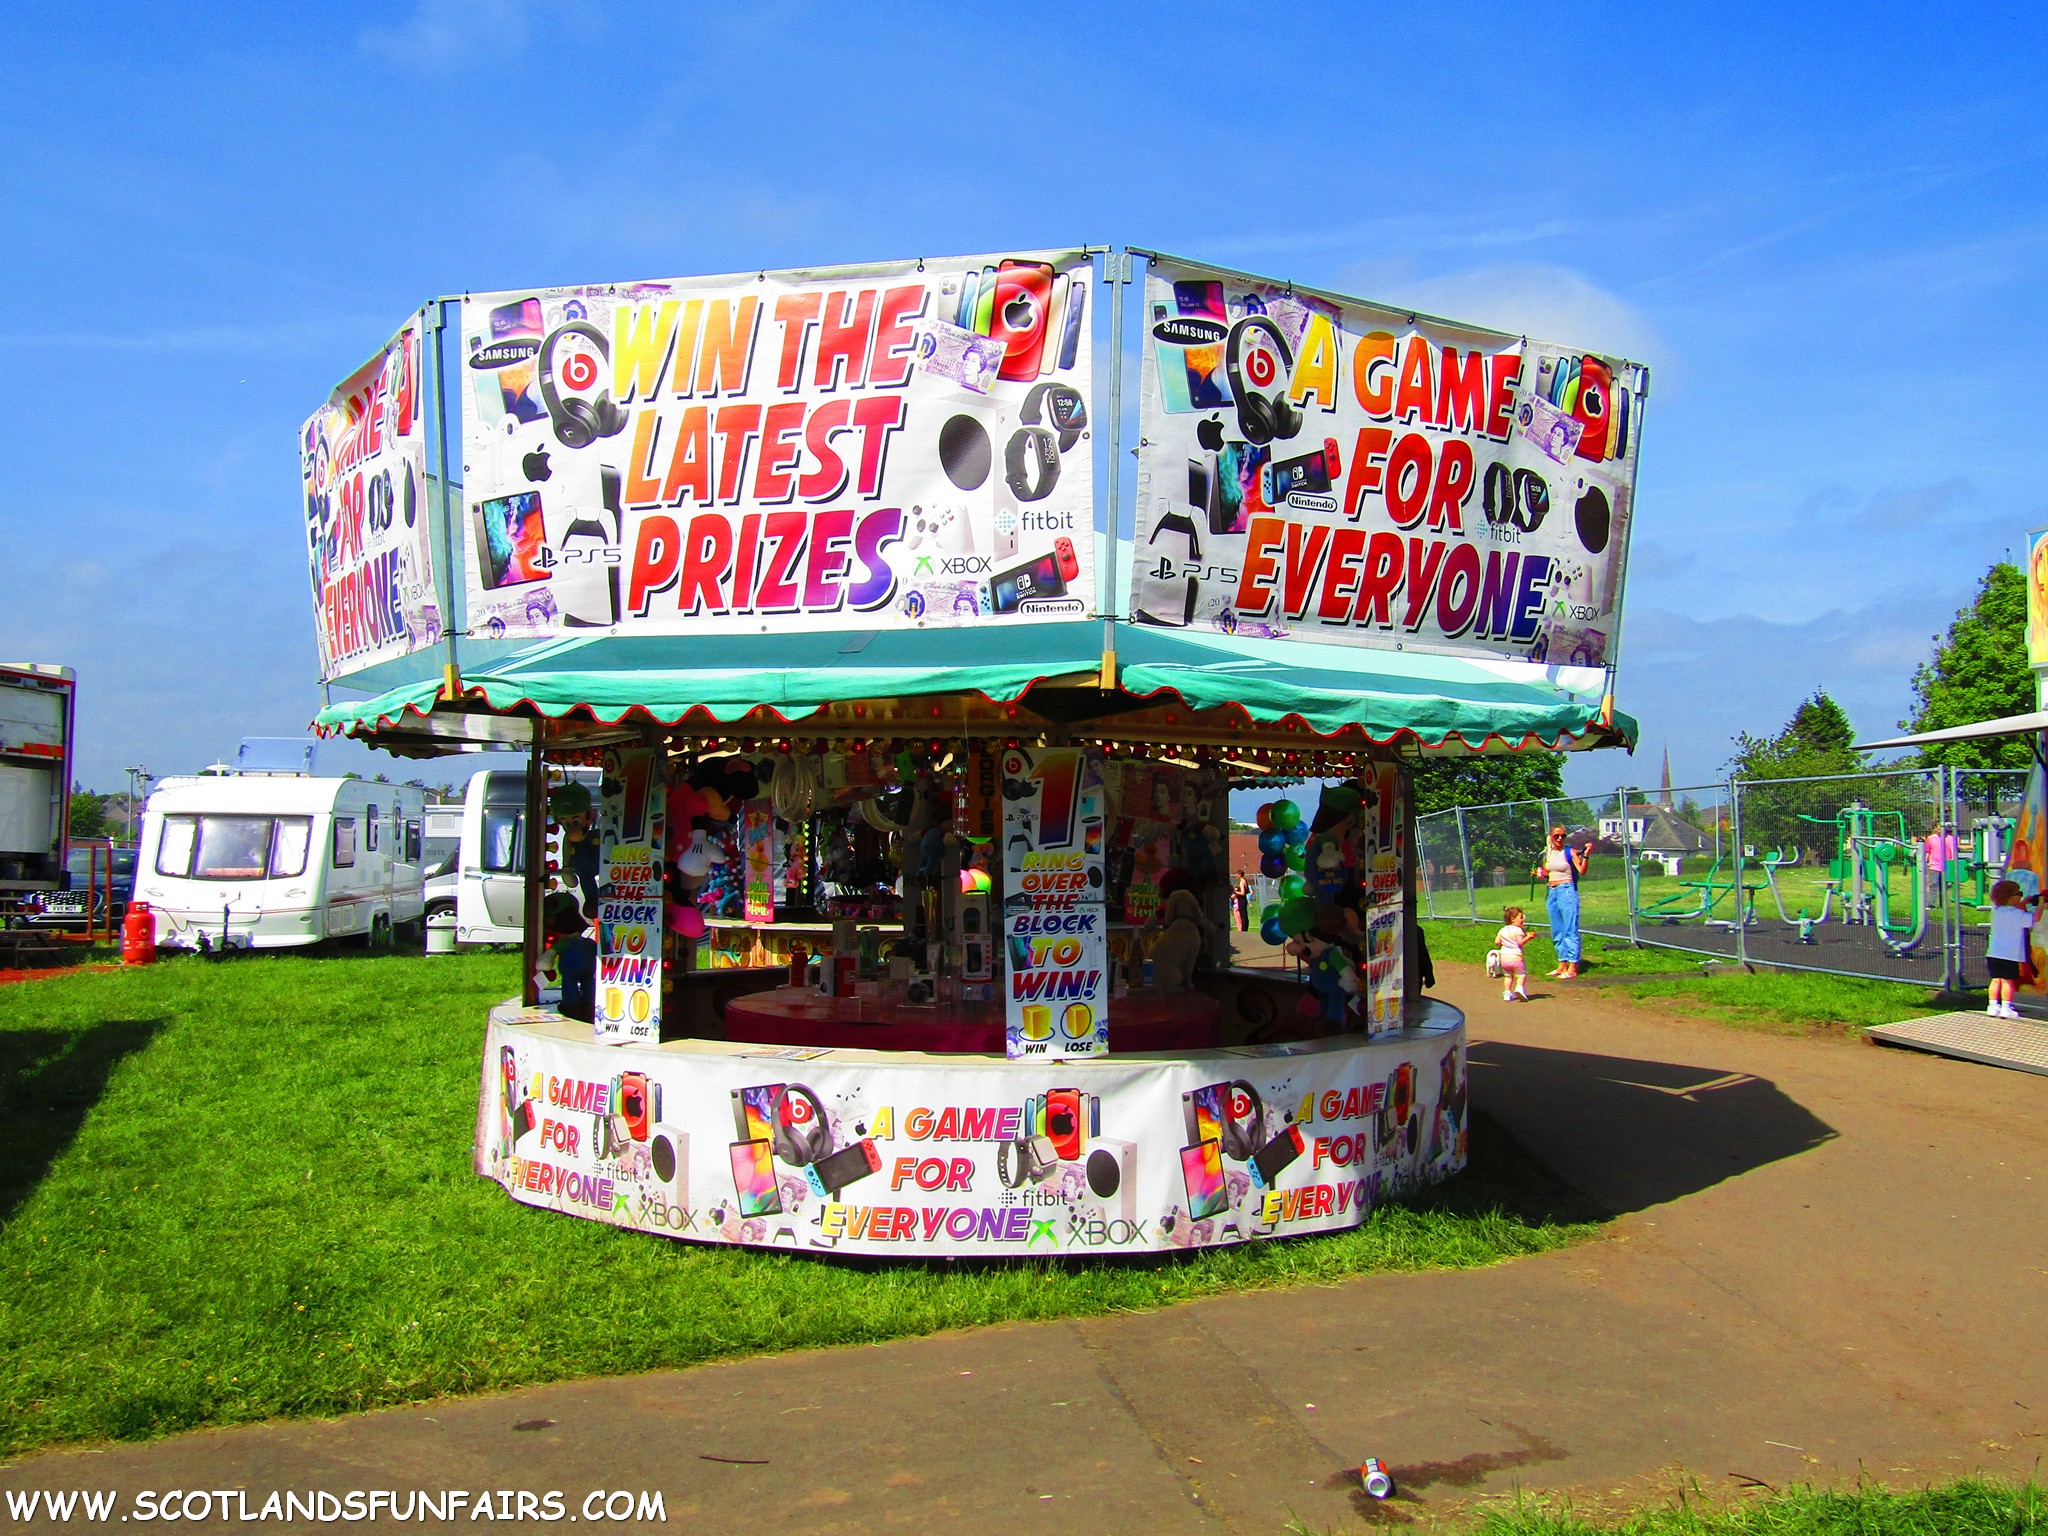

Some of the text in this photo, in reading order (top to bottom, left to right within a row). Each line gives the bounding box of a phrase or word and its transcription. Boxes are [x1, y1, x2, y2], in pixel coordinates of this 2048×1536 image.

[1163, 321, 1221, 342] SAMSUNG
[478, 347, 535, 361] SAMSUNG
[614, 285, 929, 402] WIN THE
[1288, 314, 1522, 442] A GAME
[624, 396, 905, 508] LATEST
[1343, 427, 1474, 532] FOR
[1291, 496, 1334, 509] Nintendo
[1022, 510, 1074, 531] fitbit
[1490, 523, 1522, 544] fitbit
[564, 548, 622, 564] PS5
[628, 509, 906, 615] PRIZES
[940, 556, 993, 575] XBOX
[1183, 563, 1238, 584] PS5
[1235, 516, 1553, 639] EVERYONE
[1026, 603, 1079, 614] Nintendo
[1569, 604, 1600, 621] XBOX
[619, 752, 653, 842] 1
[1028, 752, 1079, 846] 1
[610, 847, 651, 863] RING
[1021, 851, 1086, 871] RING
[610, 866, 652, 884] OVER
[1022, 873, 1088, 891] OVER
[1373, 873, 1396, 888] OVER
[616, 886, 645, 902] THE
[1031, 894, 1080, 912] THE
[603, 904, 657, 922] BLOCK
[1013, 915, 1097, 934] BLOCK
[613, 925, 646, 953] TO
[1030, 938, 1082, 966] TO
[601, 956, 656, 985] WIN!
[1012, 970, 1100, 1000] WIN!
[605, 1024, 618, 1033] WIN
[630, 1026, 649, 1036] LOSE
[1025, 1042, 1092, 1054] WIN LOSE
[528, 1071, 609, 1116] A GAME
[1295, 1082, 1386, 1124] A GAME
[868, 1106, 1021, 1142] A GAME
[540, 1118, 580, 1158] FOR
[1312, 1132, 1366, 1170] FOR
[511, 1154, 614, 1211] EVERYONE
[606, 1164, 638, 1183] fitbit
[890, 1157, 974, 1191] FOR
[1022, 1189, 1068, 1206] fitbit
[639, 1200, 699, 1232] XBOX
[821, 1202, 1032, 1241] EVERYONE
[1067, 1219, 1148, 1246] XBOX
